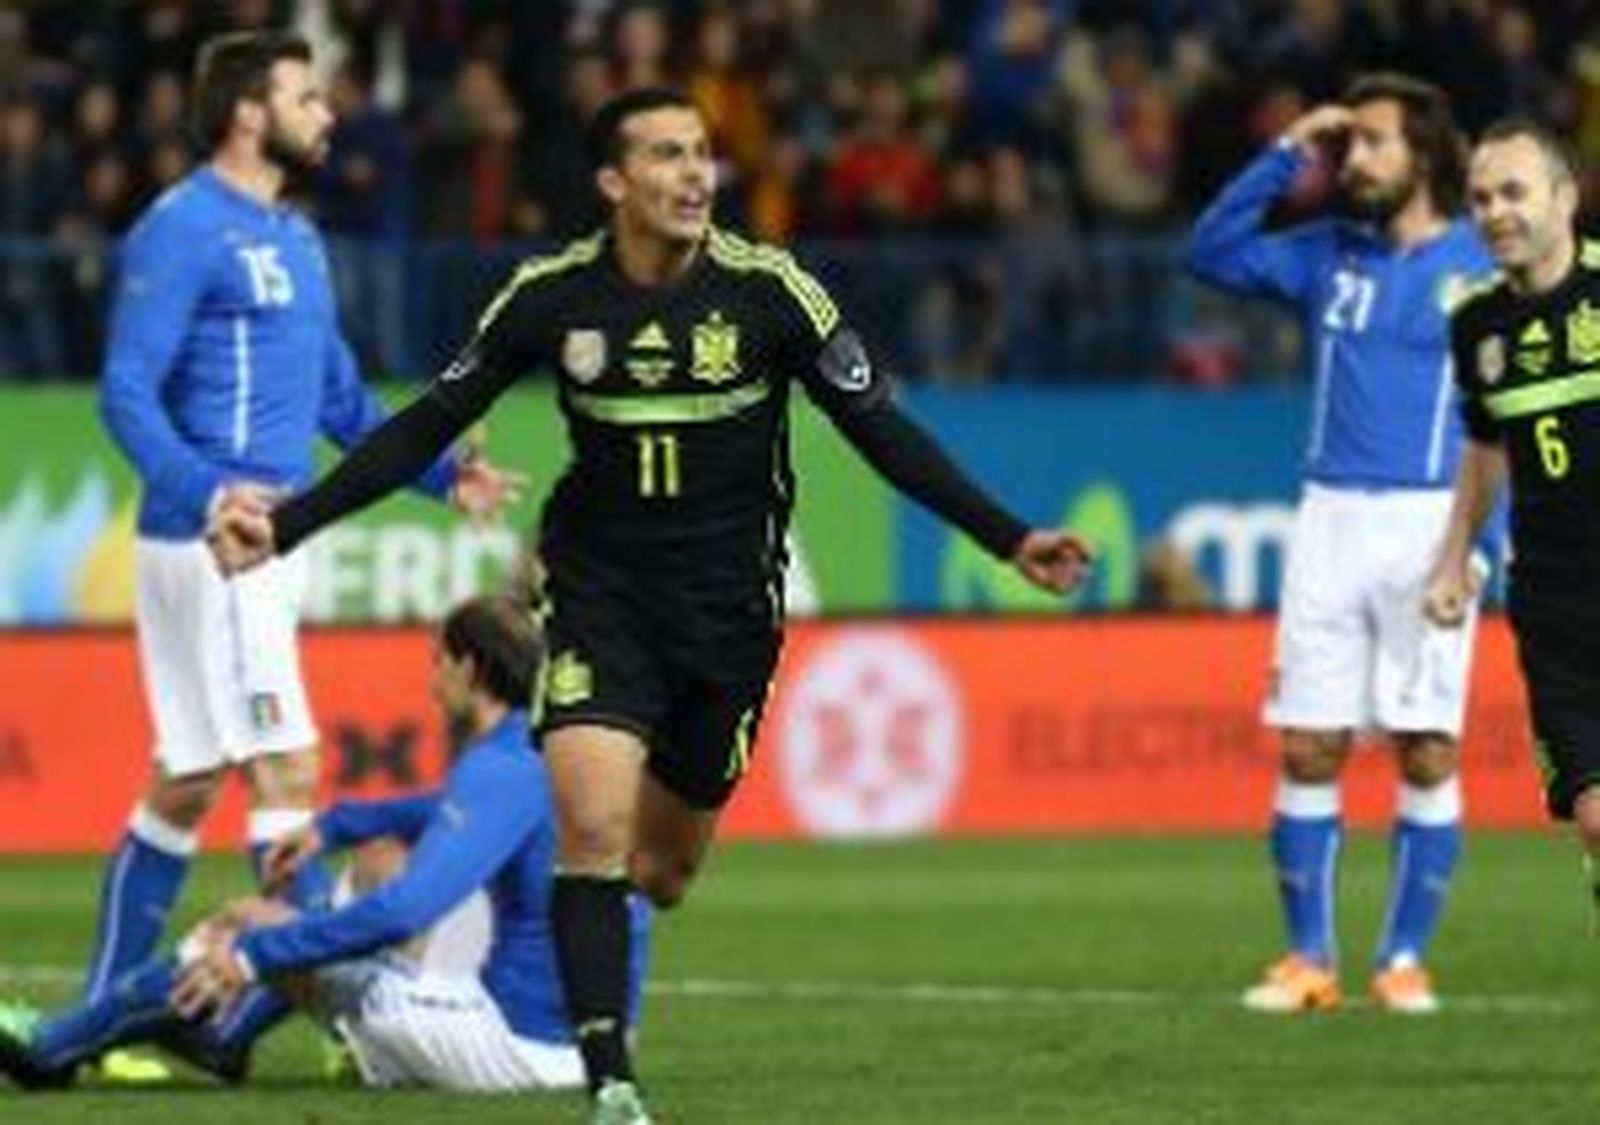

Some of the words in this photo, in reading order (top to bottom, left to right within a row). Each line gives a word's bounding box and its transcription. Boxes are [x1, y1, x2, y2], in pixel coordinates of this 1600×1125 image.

[238, 247, 293, 306] 15
[1323, 270, 1374, 332] 21
[637, 433, 680, 497] 11
[1535, 416, 1569, 478] 6
